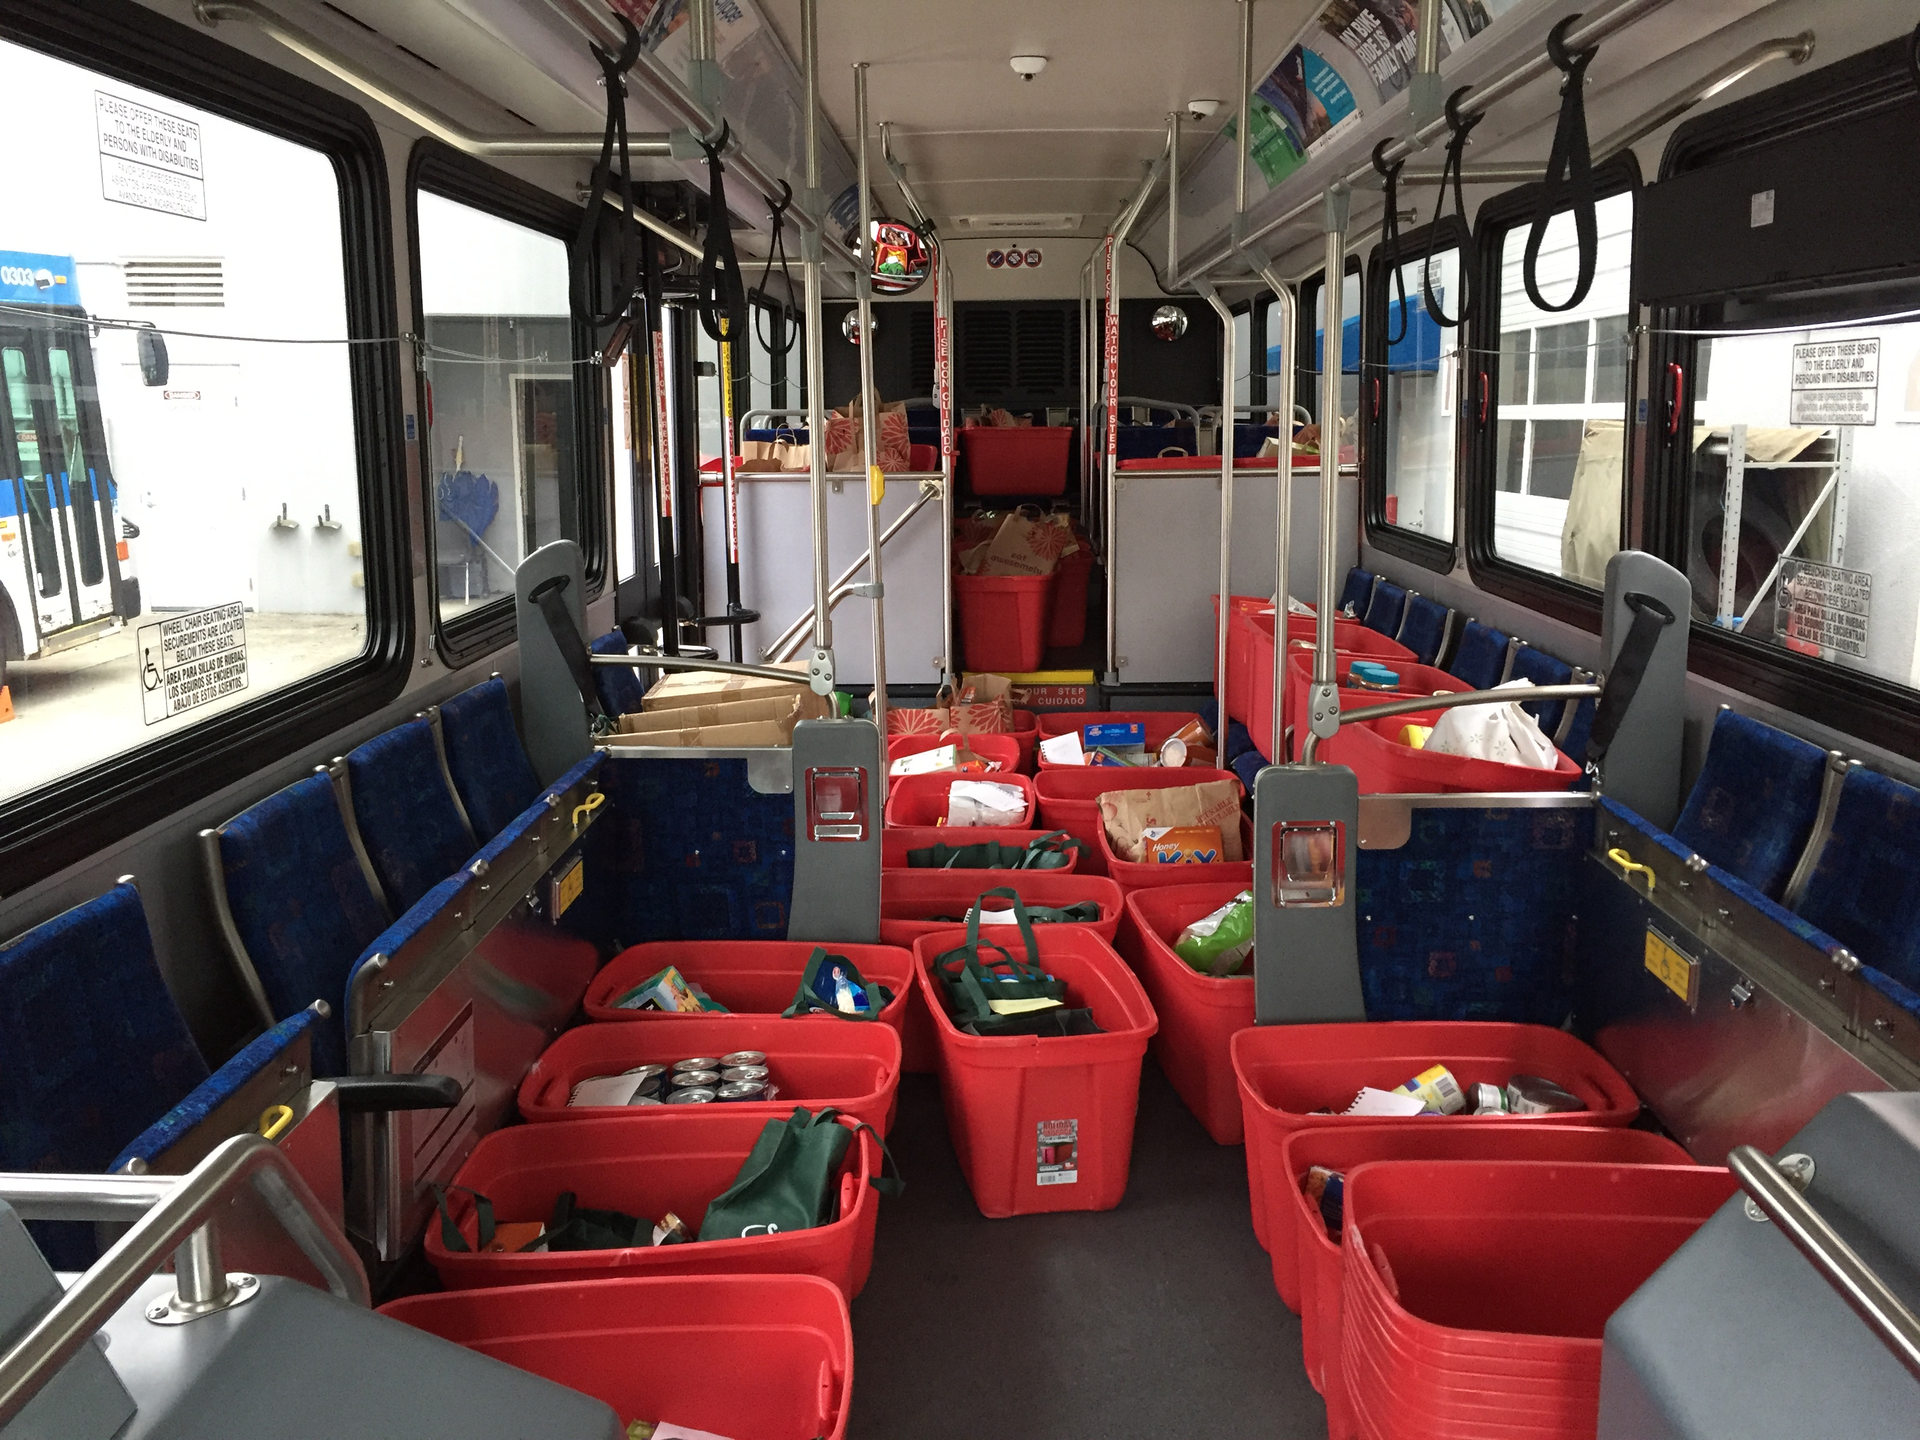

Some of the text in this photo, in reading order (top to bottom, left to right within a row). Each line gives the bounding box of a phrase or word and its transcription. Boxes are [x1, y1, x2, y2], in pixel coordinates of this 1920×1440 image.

[1339, 8, 1381, 49] MY BIKE
[1356, 30, 1390, 67] RIDE IS
[1369, 30, 1416, 87] FAMILY TIME
[99, 98, 197, 140] PLEASE OFFER THESE SEATS
[104, 133, 198, 171] PERSONS WITH DISABILITIES
[115, 120, 186, 152] TO THE ELDERLY AND
[1, 266, 34, 286] 0303
[940, 320, 948, 356] PISE
[1110, 316, 1118, 363] WATCH
[1796, 343, 1876, 358] PLEASE OFFER THESE SEATS
[657, 332, 666, 396] CAUTION
[1795, 371, 1874, 384] PERSONS WITH DISABILITIES
[1805, 358, 1864, 371] TO THE ELDERLY AND
[942, 392, 950, 454] CUIDADO
[991, 555, 1042, 575] awesomely
[1011, 553, 1027, 561] eat
[162, 621, 184, 636] WHEEL
[185, 616, 201, 631] CHAIR
[203, 610, 226, 625] SEATING
[164, 618, 242, 651] SECUREMENTS ARE LOCATED
[176, 646, 196, 662] BELOW
[198, 640, 216, 655] THESE
[168, 662, 245, 699] LOS SEGUROS SE ENCUENTRAN
[183, 665, 197, 679] PARA
[198, 659, 215, 675] SILLAS
[217, 656, 223, 669] DE
[174, 694, 191, 712] ABAJO
[193, 692, 199, 704] DE
[201, 684, 217, 701] ESTOS
[1152, 843, 1180, 852] Honey
